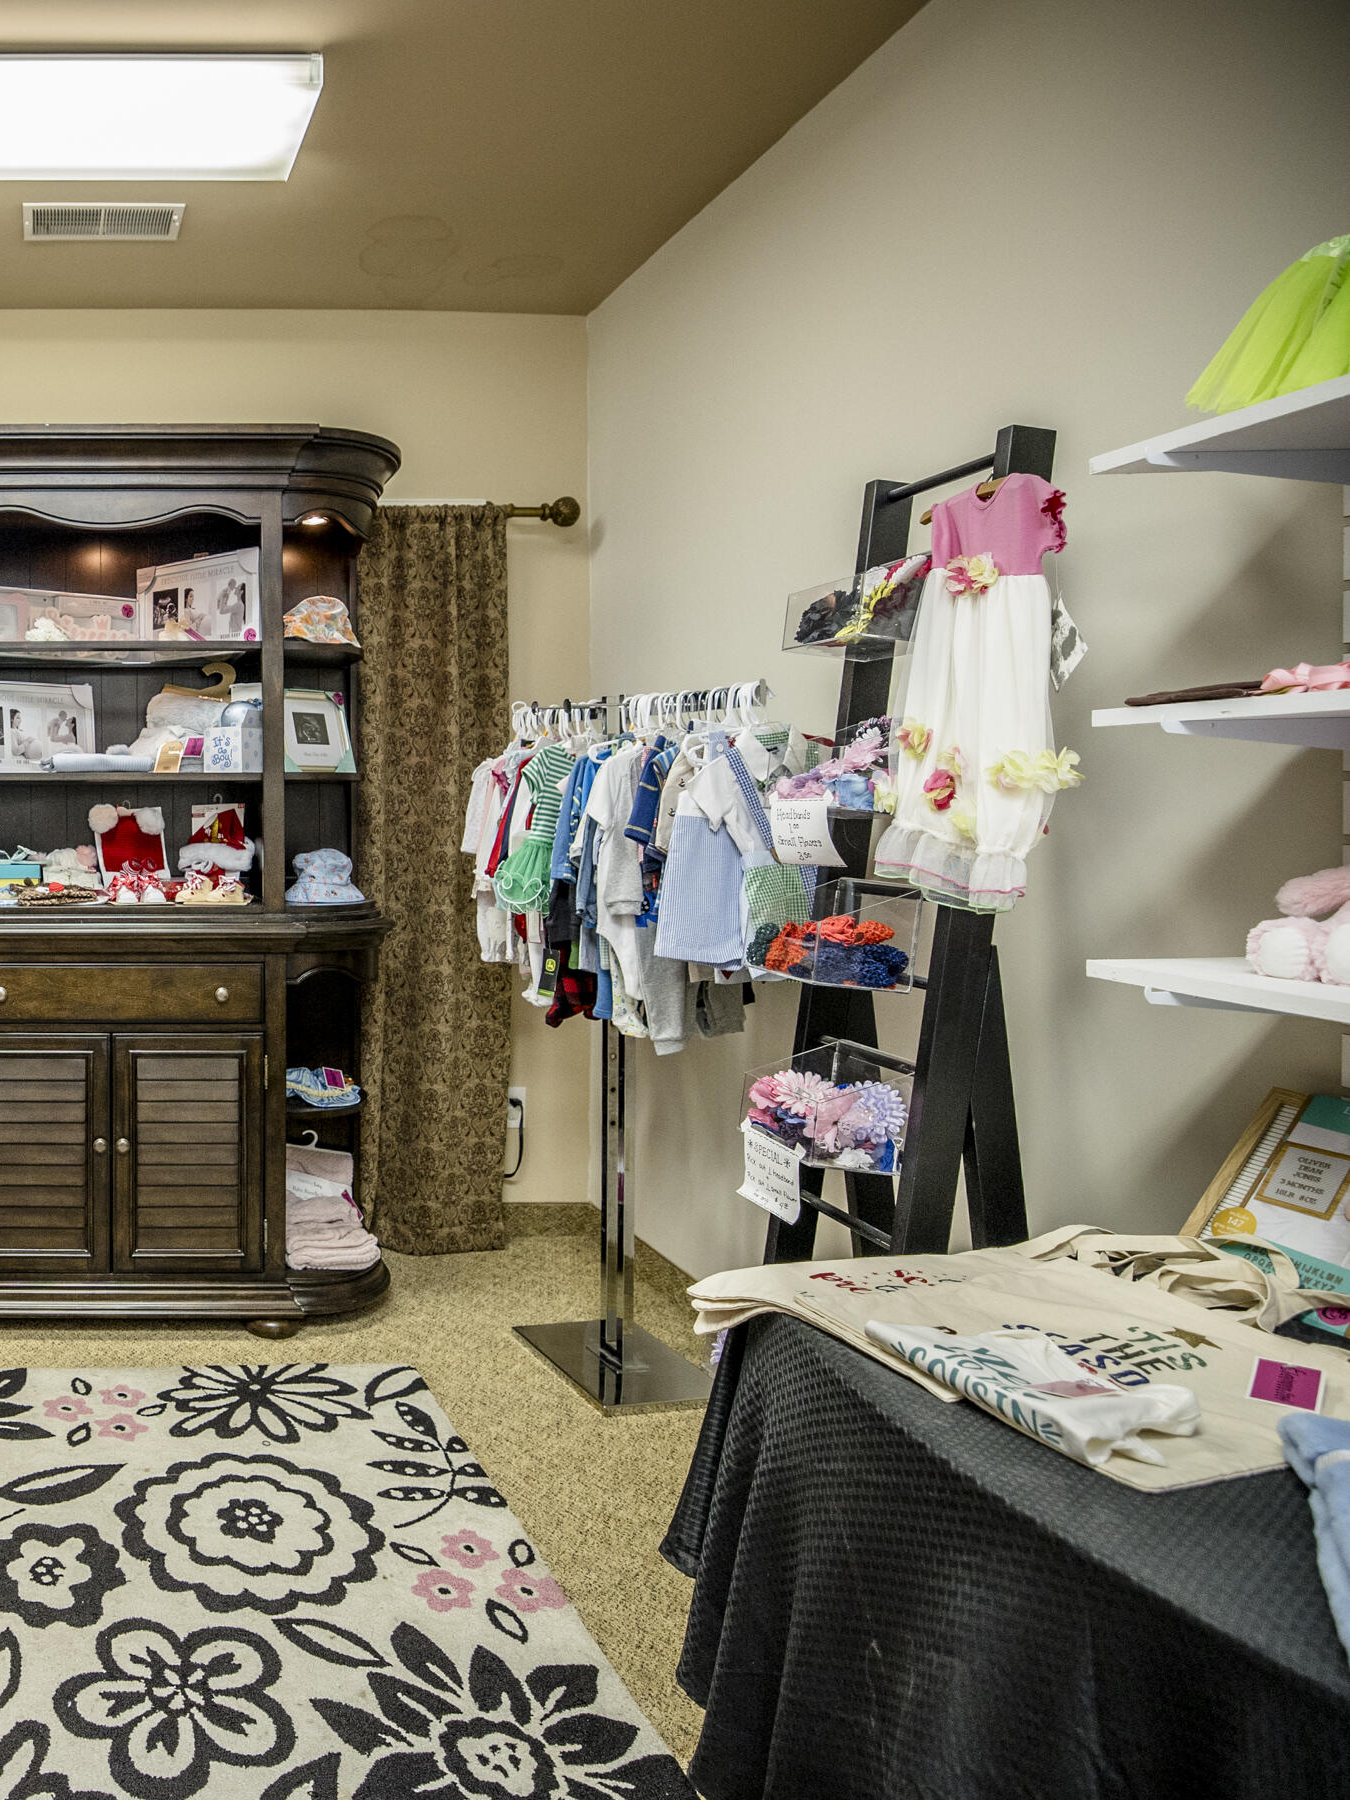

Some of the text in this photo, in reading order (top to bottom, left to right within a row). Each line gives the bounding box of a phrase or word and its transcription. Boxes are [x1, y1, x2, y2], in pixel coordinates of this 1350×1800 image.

[208, 566, 234, 578] MIRACLE
[37, 696, 64, 705] MIRACLE
[212, 735, 230, 748] It's
[218, 747, 228, 755] a
[212, 749, 232, 768] Boy!
[776, 808, 811, 820] Headbands
[778, 834, 797, 847] Small
[754, 1142, 783, 1166] SPECIAL
[1298, 1156, 1331, 1170] OLIVER
[1298, 1164, 1324, 1175] DEAN
[1292, 1171, 1322, 1182] JONES
[1286, 1180, 1324, 1195] MONTHS
[1227, 1216, 1246, 1228] 147
[1079, 1332, 1176, 1374] THE
[1127, 1326, 1208, 1370] 'TIS
[908, 1346, 1040, 1436] COUSIN
